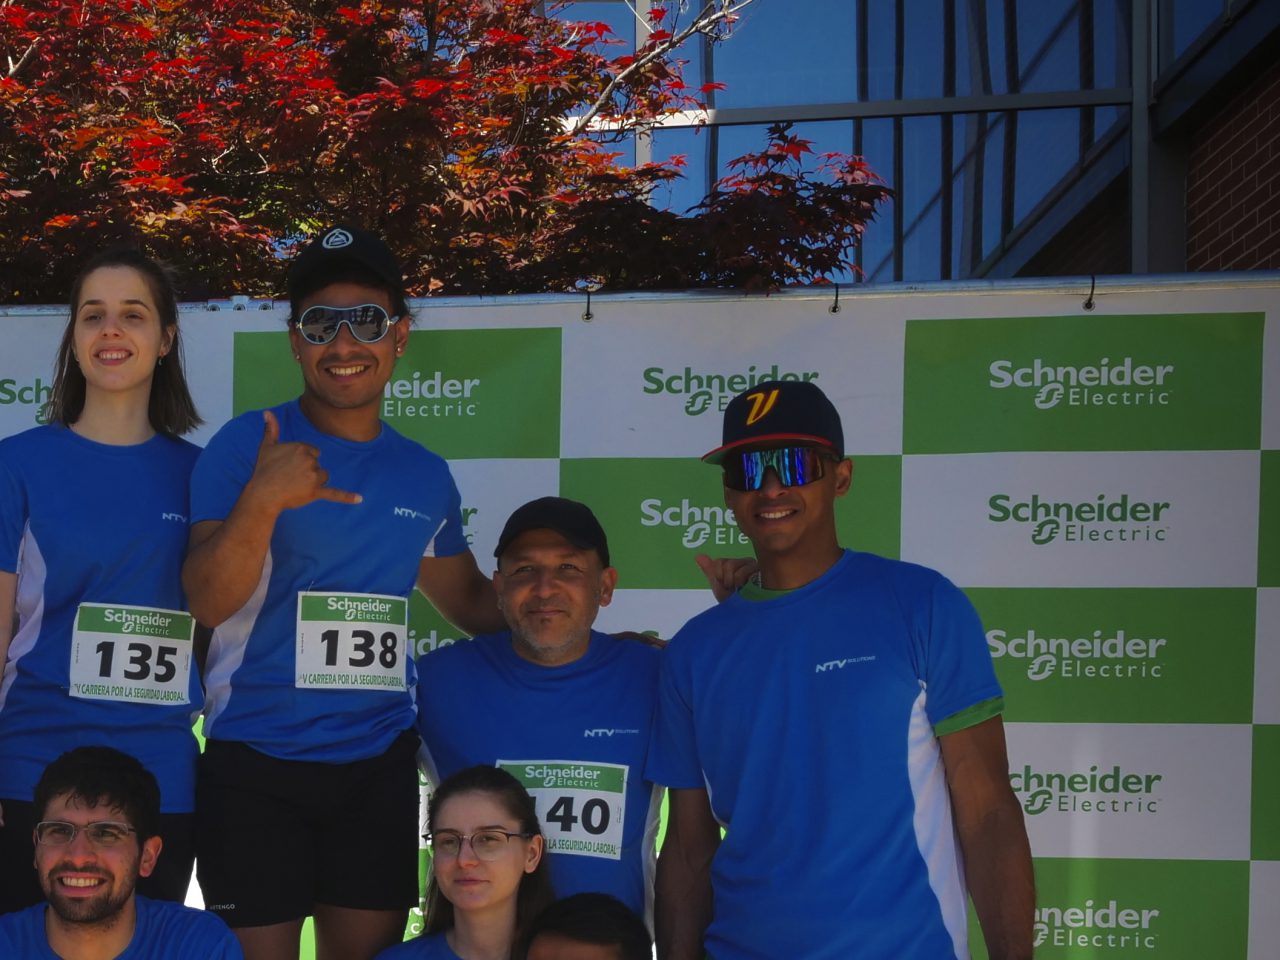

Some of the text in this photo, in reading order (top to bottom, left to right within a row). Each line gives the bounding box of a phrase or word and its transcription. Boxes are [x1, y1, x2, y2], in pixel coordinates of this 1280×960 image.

[989, 357, 1174, 388] Schneider
[384, 371, 480, 398] eider
[1069, 388, 1169, 405] Electric
[383, 400, 477, 417] Electric
[394, 507, 417, 519] NTV
[640, 499, 737, 526] Schne
[988, 494, 1170, 522] Schneider
[1065, 525, 1166, 541] Electric
[327, 597, 392, 613] Schneider
[104, 608, 172, 627] Schneider
[357, 611, 391, 621] Electric
[135, 624, 169, 636] Electric
[320, 629, 398, 669] 138
[985, 629, 1167, 658] Schneider
[95, 640, 178, 683] 135
[815, 659, 847, 673] NTV
[1061, 660, 1162, 677] Electric
[308, 673, 337, 685] CARRERA
[338, 674, 350, 685] POR
[350, 674, 359, 685] LA
[81, 684, 110, 696] CARRERA
[111, 686, 124, 697] POR
[124, 687, 133, 698] LA
[133, 688, 160, 699] SEGURIDAD
[160, 690, 185, 701] LABORAL
[584, 728, 614, 738] NTV
[525, 765, 600, 779] Schneider
[1010, 765, 1162, 793] chneider
[557, 775, 599, 788] Electric
[1058, 796, 1157, 812] Electric
[548, 839, 617, 855] LA SEGURIDAD LABORAL
[1035, 900, 1160, 929] neider
[1053, 929, 1155, 948] Electric
